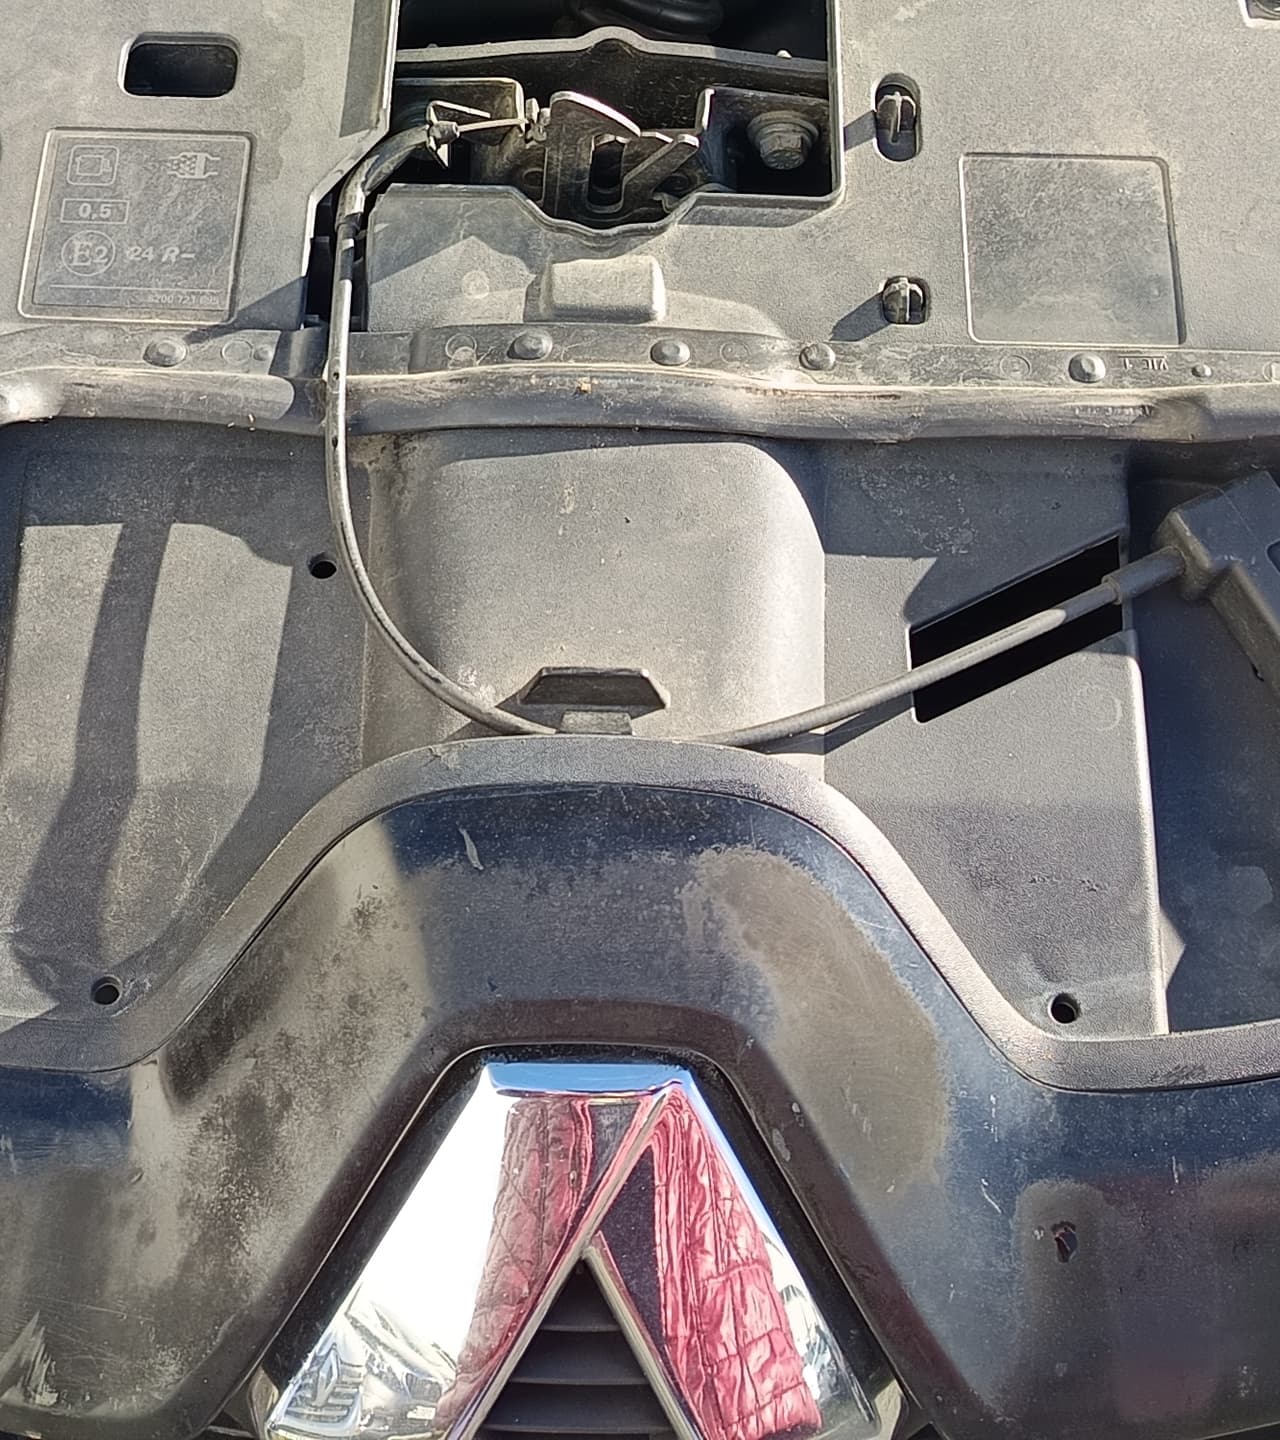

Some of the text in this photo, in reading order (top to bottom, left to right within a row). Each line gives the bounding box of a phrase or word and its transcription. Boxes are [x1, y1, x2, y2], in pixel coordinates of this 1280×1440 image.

[78, 202, 112, 220] 0,5
[70, 240, 110, 266] E2
[127, 245, 155, 263] 24
